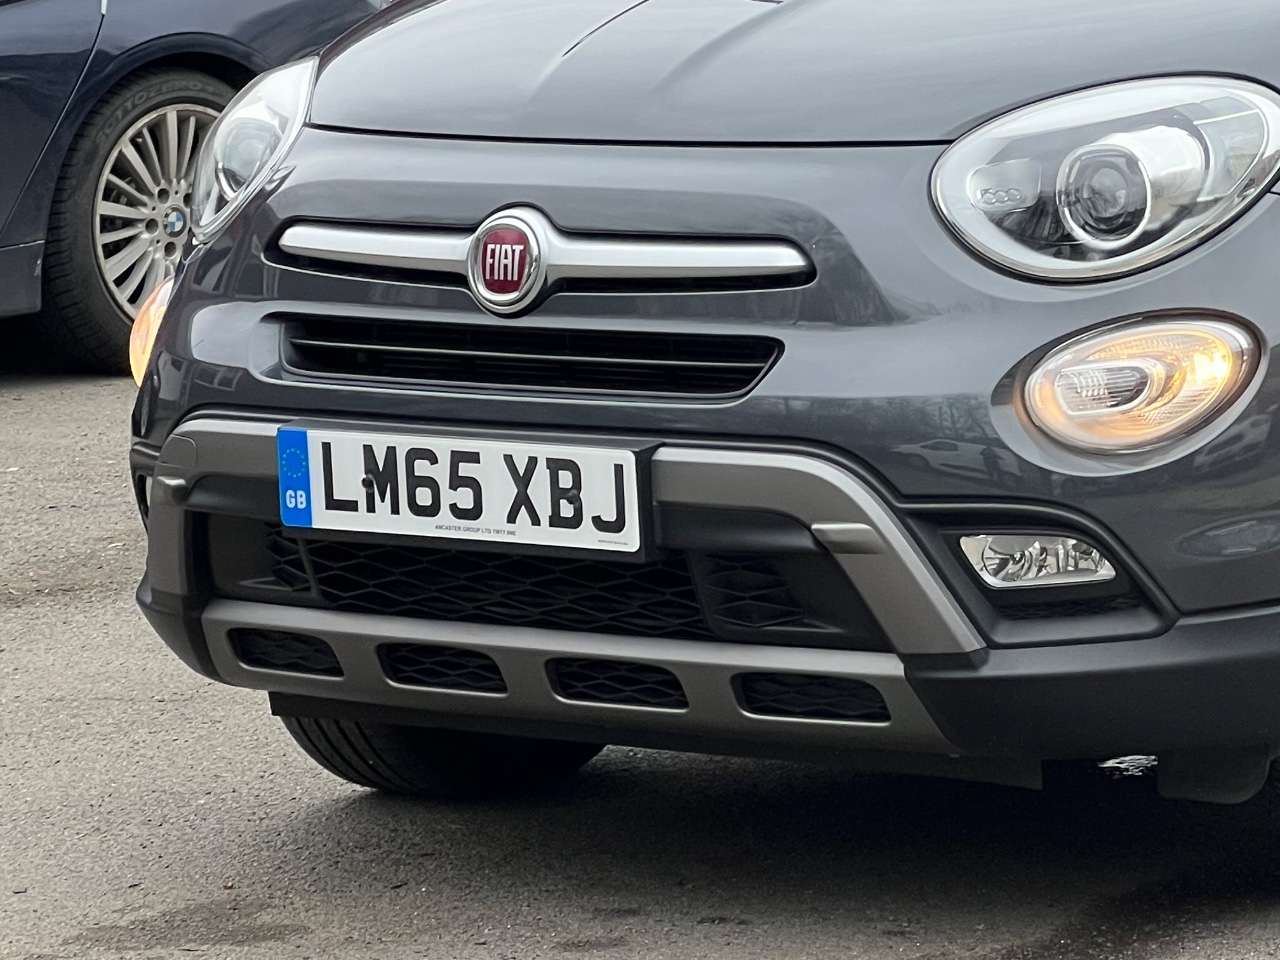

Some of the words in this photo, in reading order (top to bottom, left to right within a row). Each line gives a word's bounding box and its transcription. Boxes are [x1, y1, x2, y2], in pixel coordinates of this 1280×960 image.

[485, 243, 524, 281] FIAT
[285, 489, 307, 509] GB
[321, 442, 483, 521] LM65
[503, 454, 626, 534] XBJ
